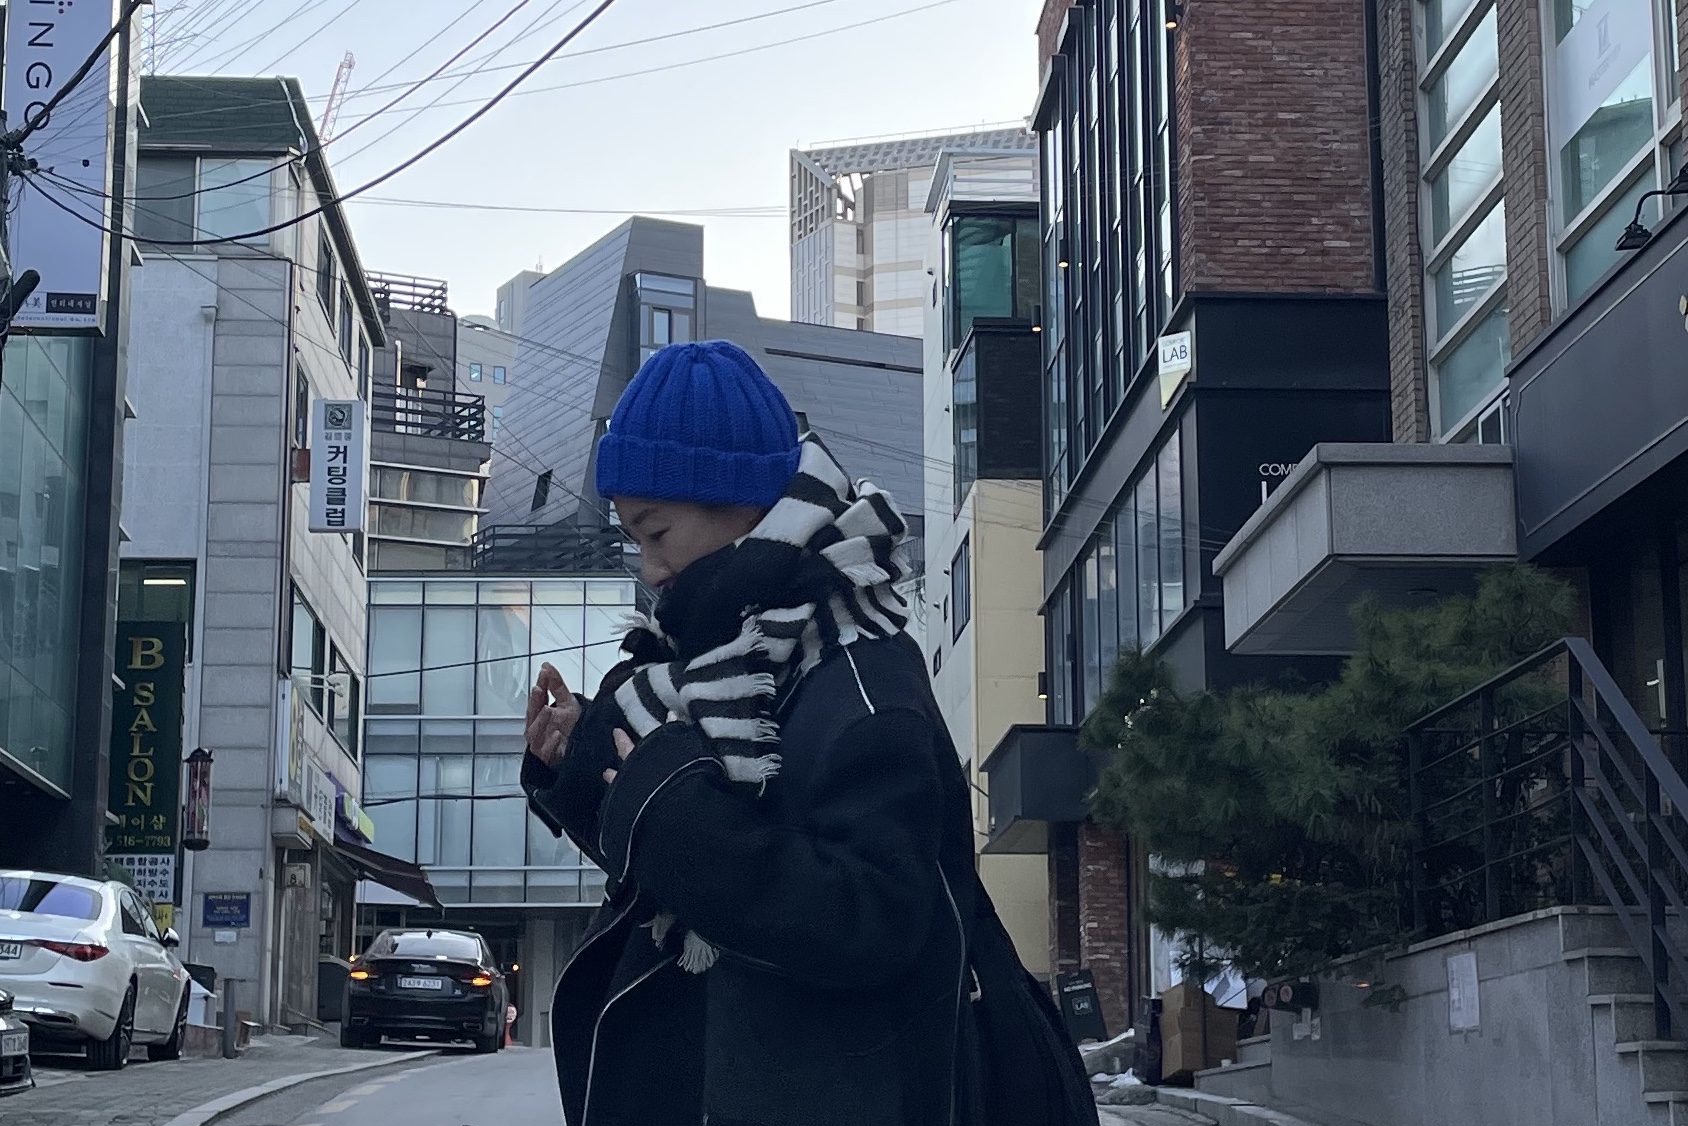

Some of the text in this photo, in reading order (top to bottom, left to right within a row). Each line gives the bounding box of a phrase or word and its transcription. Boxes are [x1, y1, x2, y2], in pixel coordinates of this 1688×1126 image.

[1162, 344, 1188, 363] LAB
[325, 445, 348, 527] 커팅클럽
[124, 636, 165, 807] B SALON
